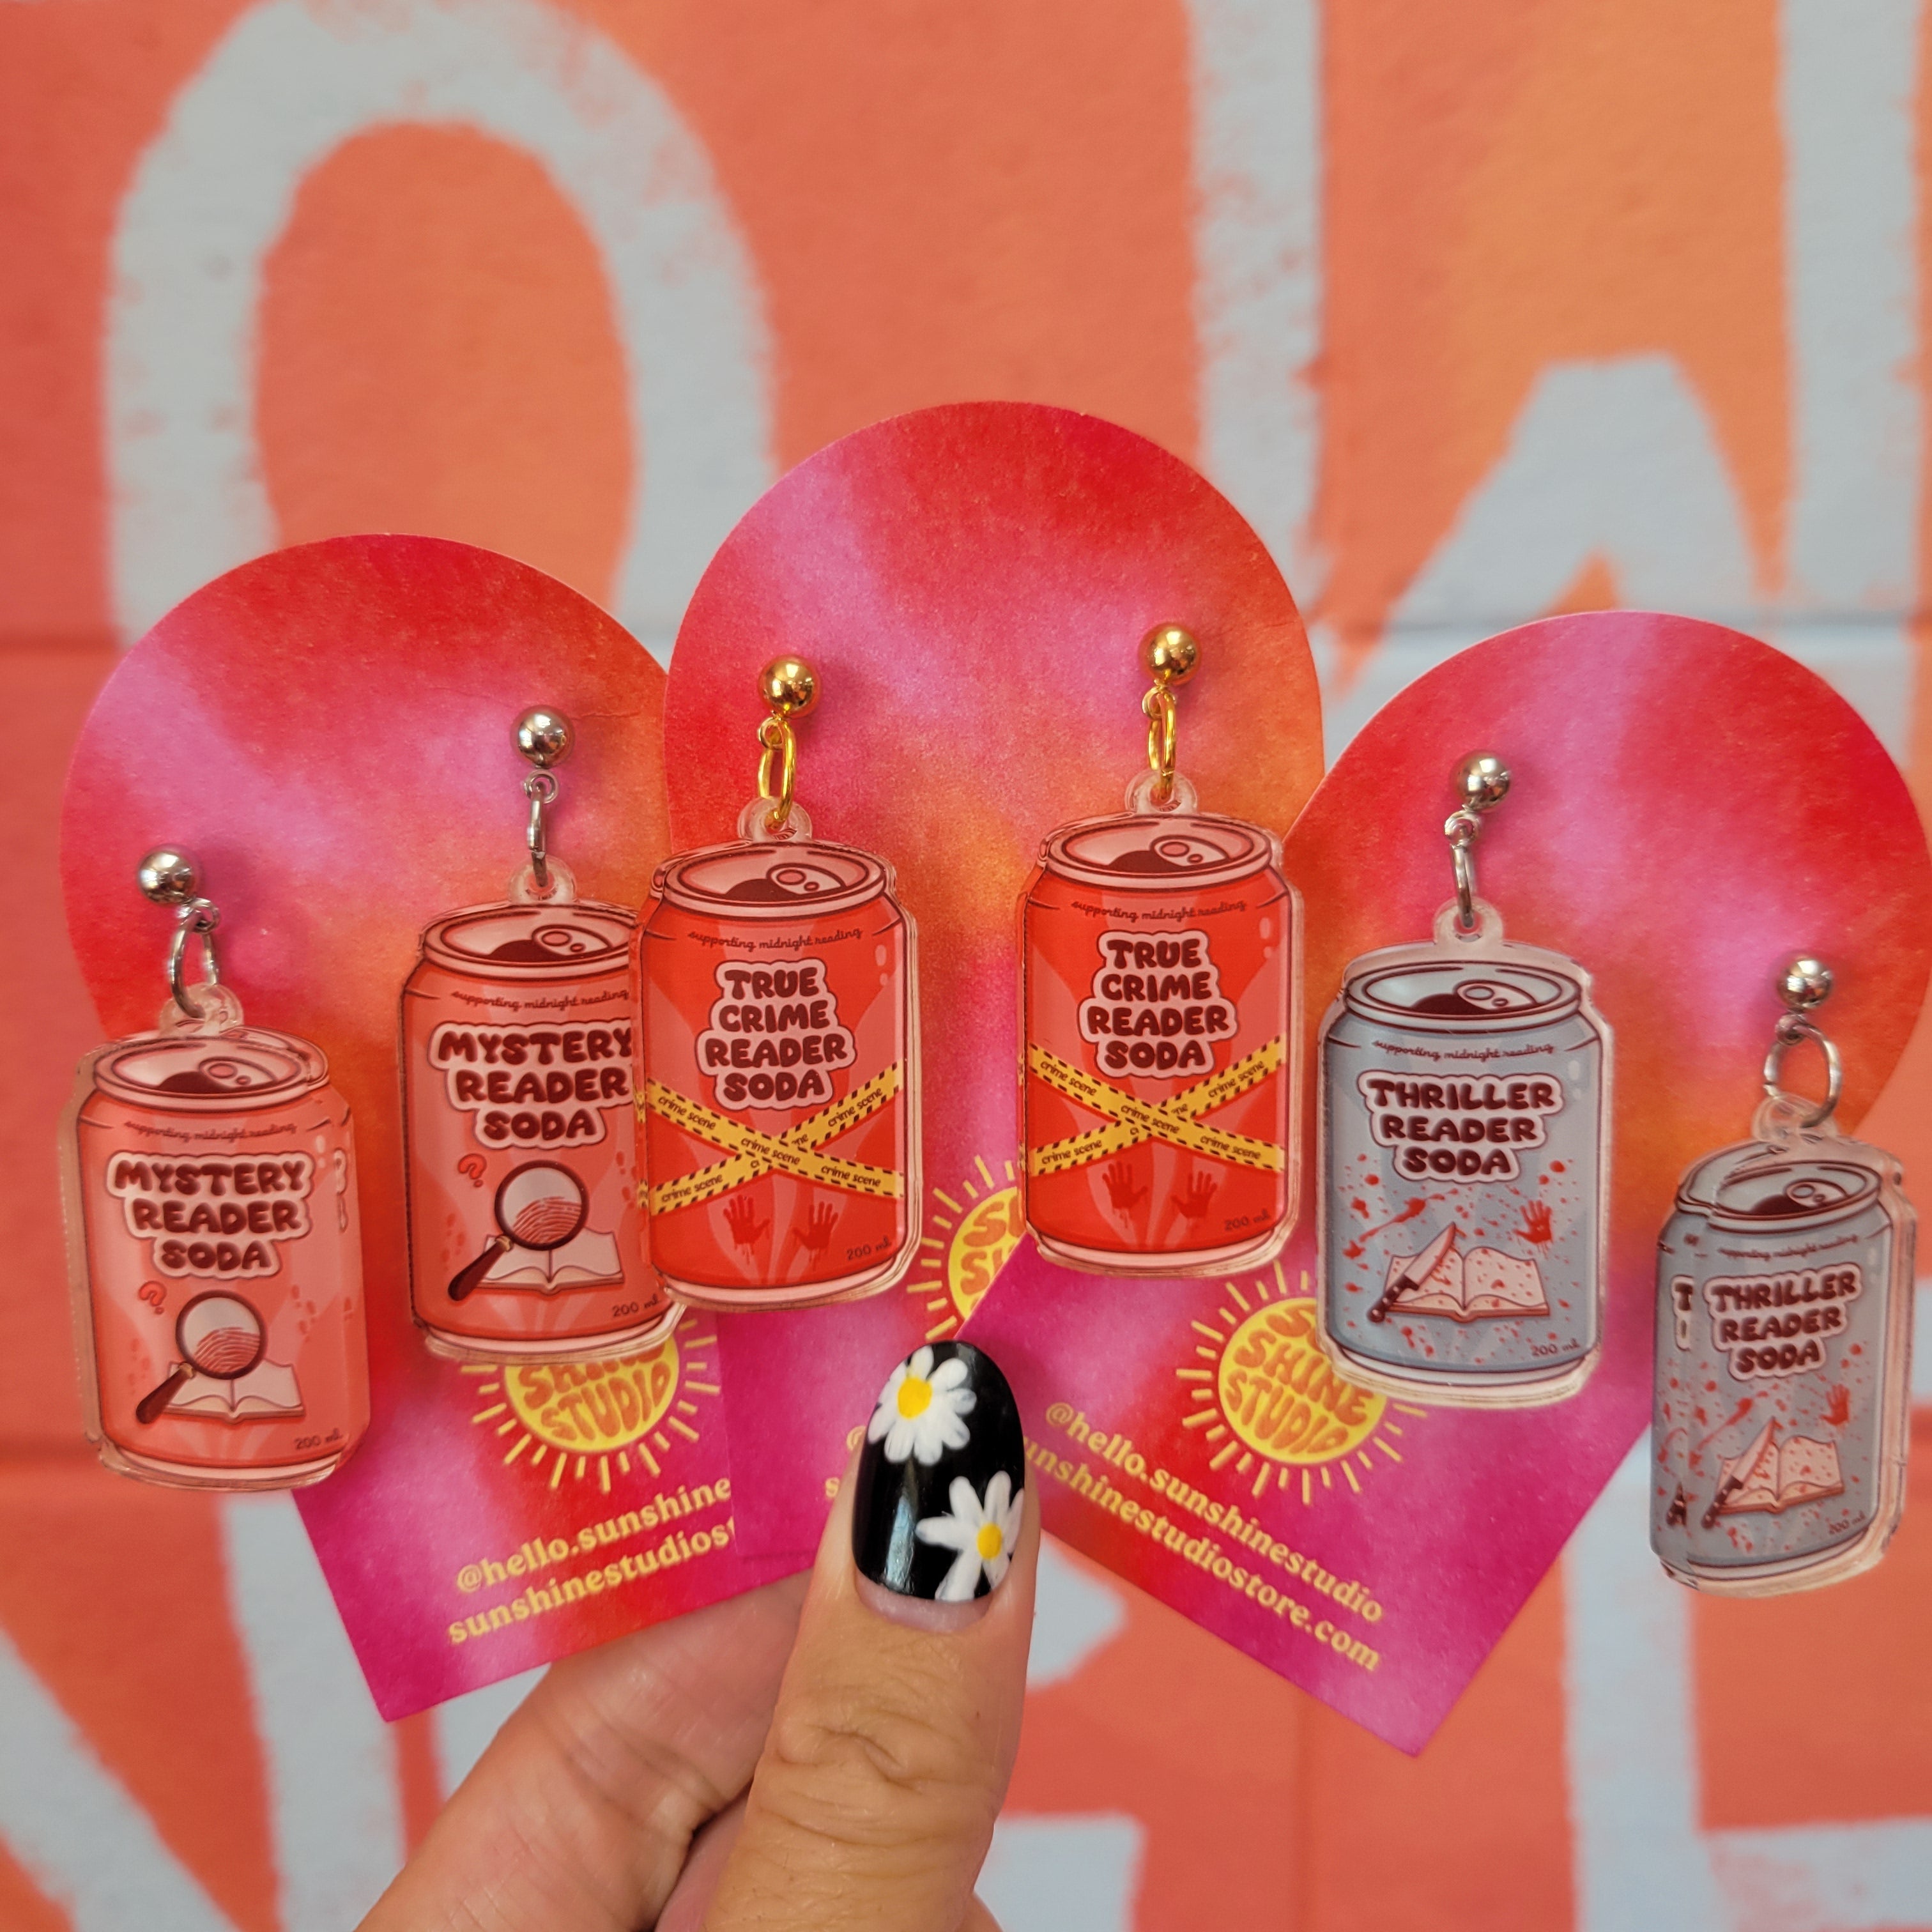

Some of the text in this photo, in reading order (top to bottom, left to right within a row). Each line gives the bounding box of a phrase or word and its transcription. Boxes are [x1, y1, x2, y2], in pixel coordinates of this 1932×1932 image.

[1140, 901, 1195, 921] midnight
[688, 930, 756, 951] supporting
[758, 930, 813, 949] midnight
[1106, 938, 1202, 970] TRUE
[724, 967, 820, 1000] TRUE
[1100, 971, 1212, 1002] CRIME
[452, 990, 519, 1011] supporting
[524, 994, 579, 1010] midnight
[718, 1000, 830, 1034] CRIME
[1086, 1004, 1230, 1037] READER
[438, 1027, 631, 1065] MYSTERY
[705, 1034, 848, 1068] READER
[1103, 1039, 1206, 1070] SODA
[456, 1066, 629, 1103] READER
[723, 1070, 825, 1102] SODA
[1040, 1060, 1098, 1097] crime scene
[1208, 1061, 1265, 1098] crime scene
[1366, 1079, 1555, 1110] THRILLER
[658, 1095, 716, 1131] crime scene
[828, 1087, 884, 1128] crime scene
[1121, 1103, 1150, 1123] crime
[1151, 1119, 1180, 1135] scene
[484, 1108, 595, 1142] SODA
[1379, 1114, 1538, 1144] READER
[740, 1136, 770, 1156] crime
[772, 1150, 801, 1166] scene
[1041, 1149, 1071, 1166] crime
[1200, 1135, 1230, 1153] crime
[114, 1160, 306, 1195] MYSTERY
[821, 1164, 881, 1188] crime scene
[1402, 1147, 1510, 1176] SODA
[661, 1172, 723, 1203] crime scene
[131, 1199, 302, 1234] READER
[1225, 1216, 1250, 1232] 200
[162, 1240, 271, 1271] SODA
[846, 1245, 871, 1261] 200
[1710, 1271, 1857, 1310] THRILLER
[612, 1301, 638, 1317] 200
[1720, 1306, 1842, 1342] READER
[1736, 1338, 1820, 1373] SODA
[540, 1361, 671, 1441] STUDIO
[1225, 1368, 1349, 1455] STUDIO
[1045, 1402, 1384, 1623] @hello.sunshinestudio
[456, 1477, 732, 1593] @hello.sunshine
[1023, 1435, 1381, 1671] unshinestudiostore.com
